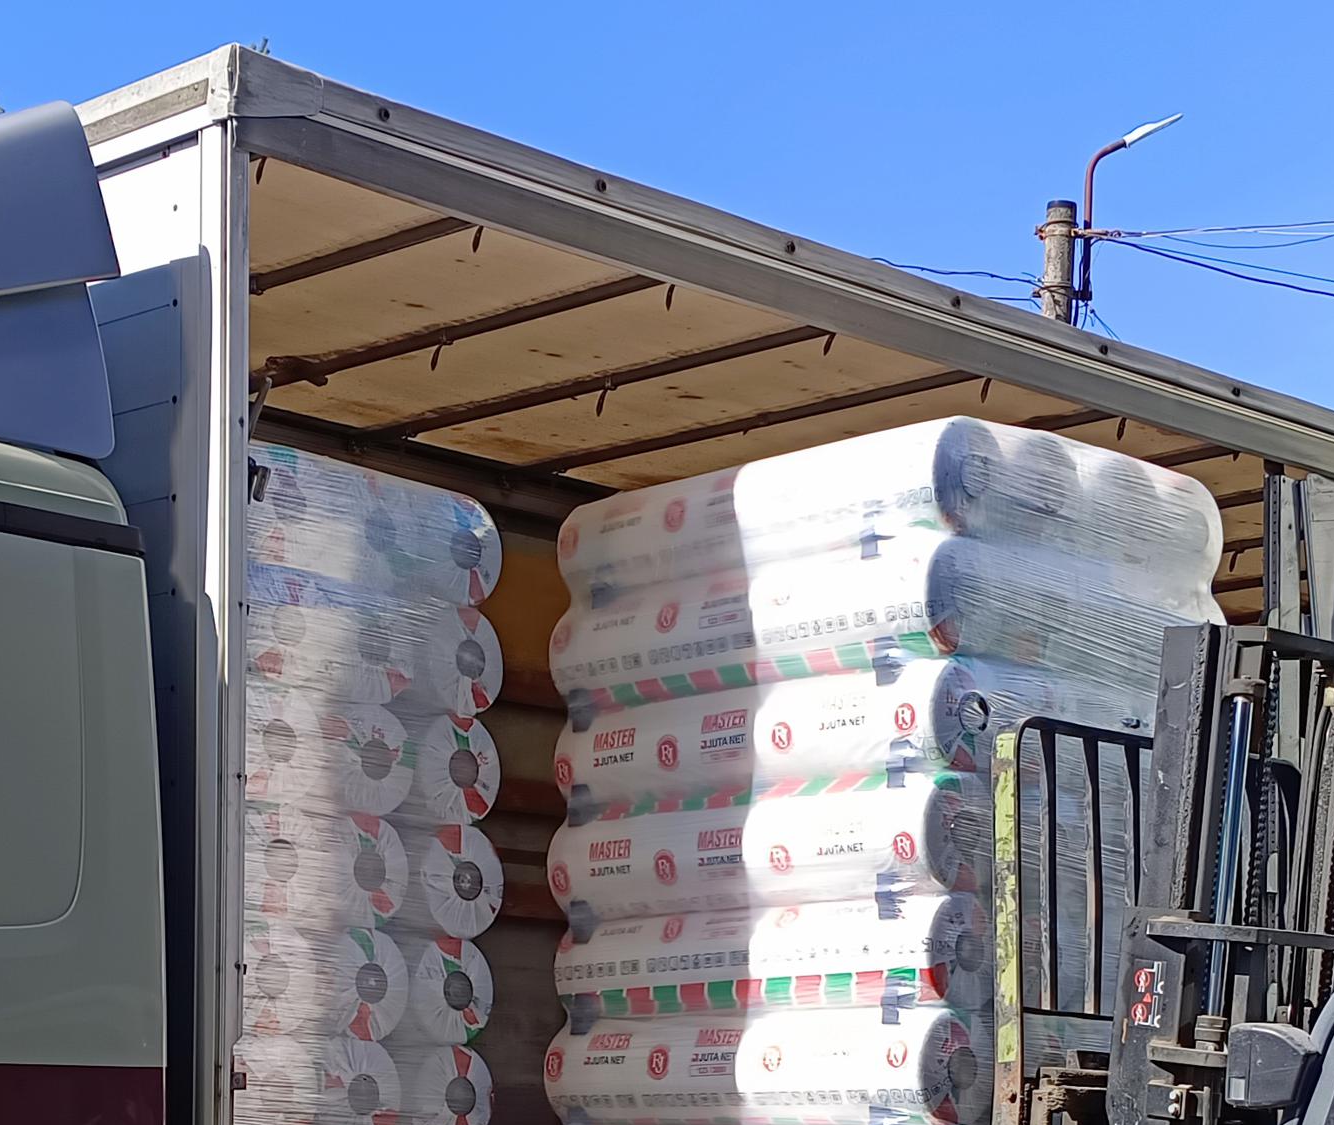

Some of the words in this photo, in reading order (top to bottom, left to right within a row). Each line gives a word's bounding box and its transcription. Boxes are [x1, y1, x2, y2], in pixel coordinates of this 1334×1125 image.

[849, 716, 865, 726] NET
[594, 728, 636, 752] MASTER
[599, 754, 618, 767] JUTA
[619, 752, 634, 763] NET
[589, 839, 631, 861] MASTER
[847, 843, 864, 852] NET
[596, 866, 614, 877] JUTA
[616, 864, 631, 875] NET
[610, 1055, 626, 1065] NET
